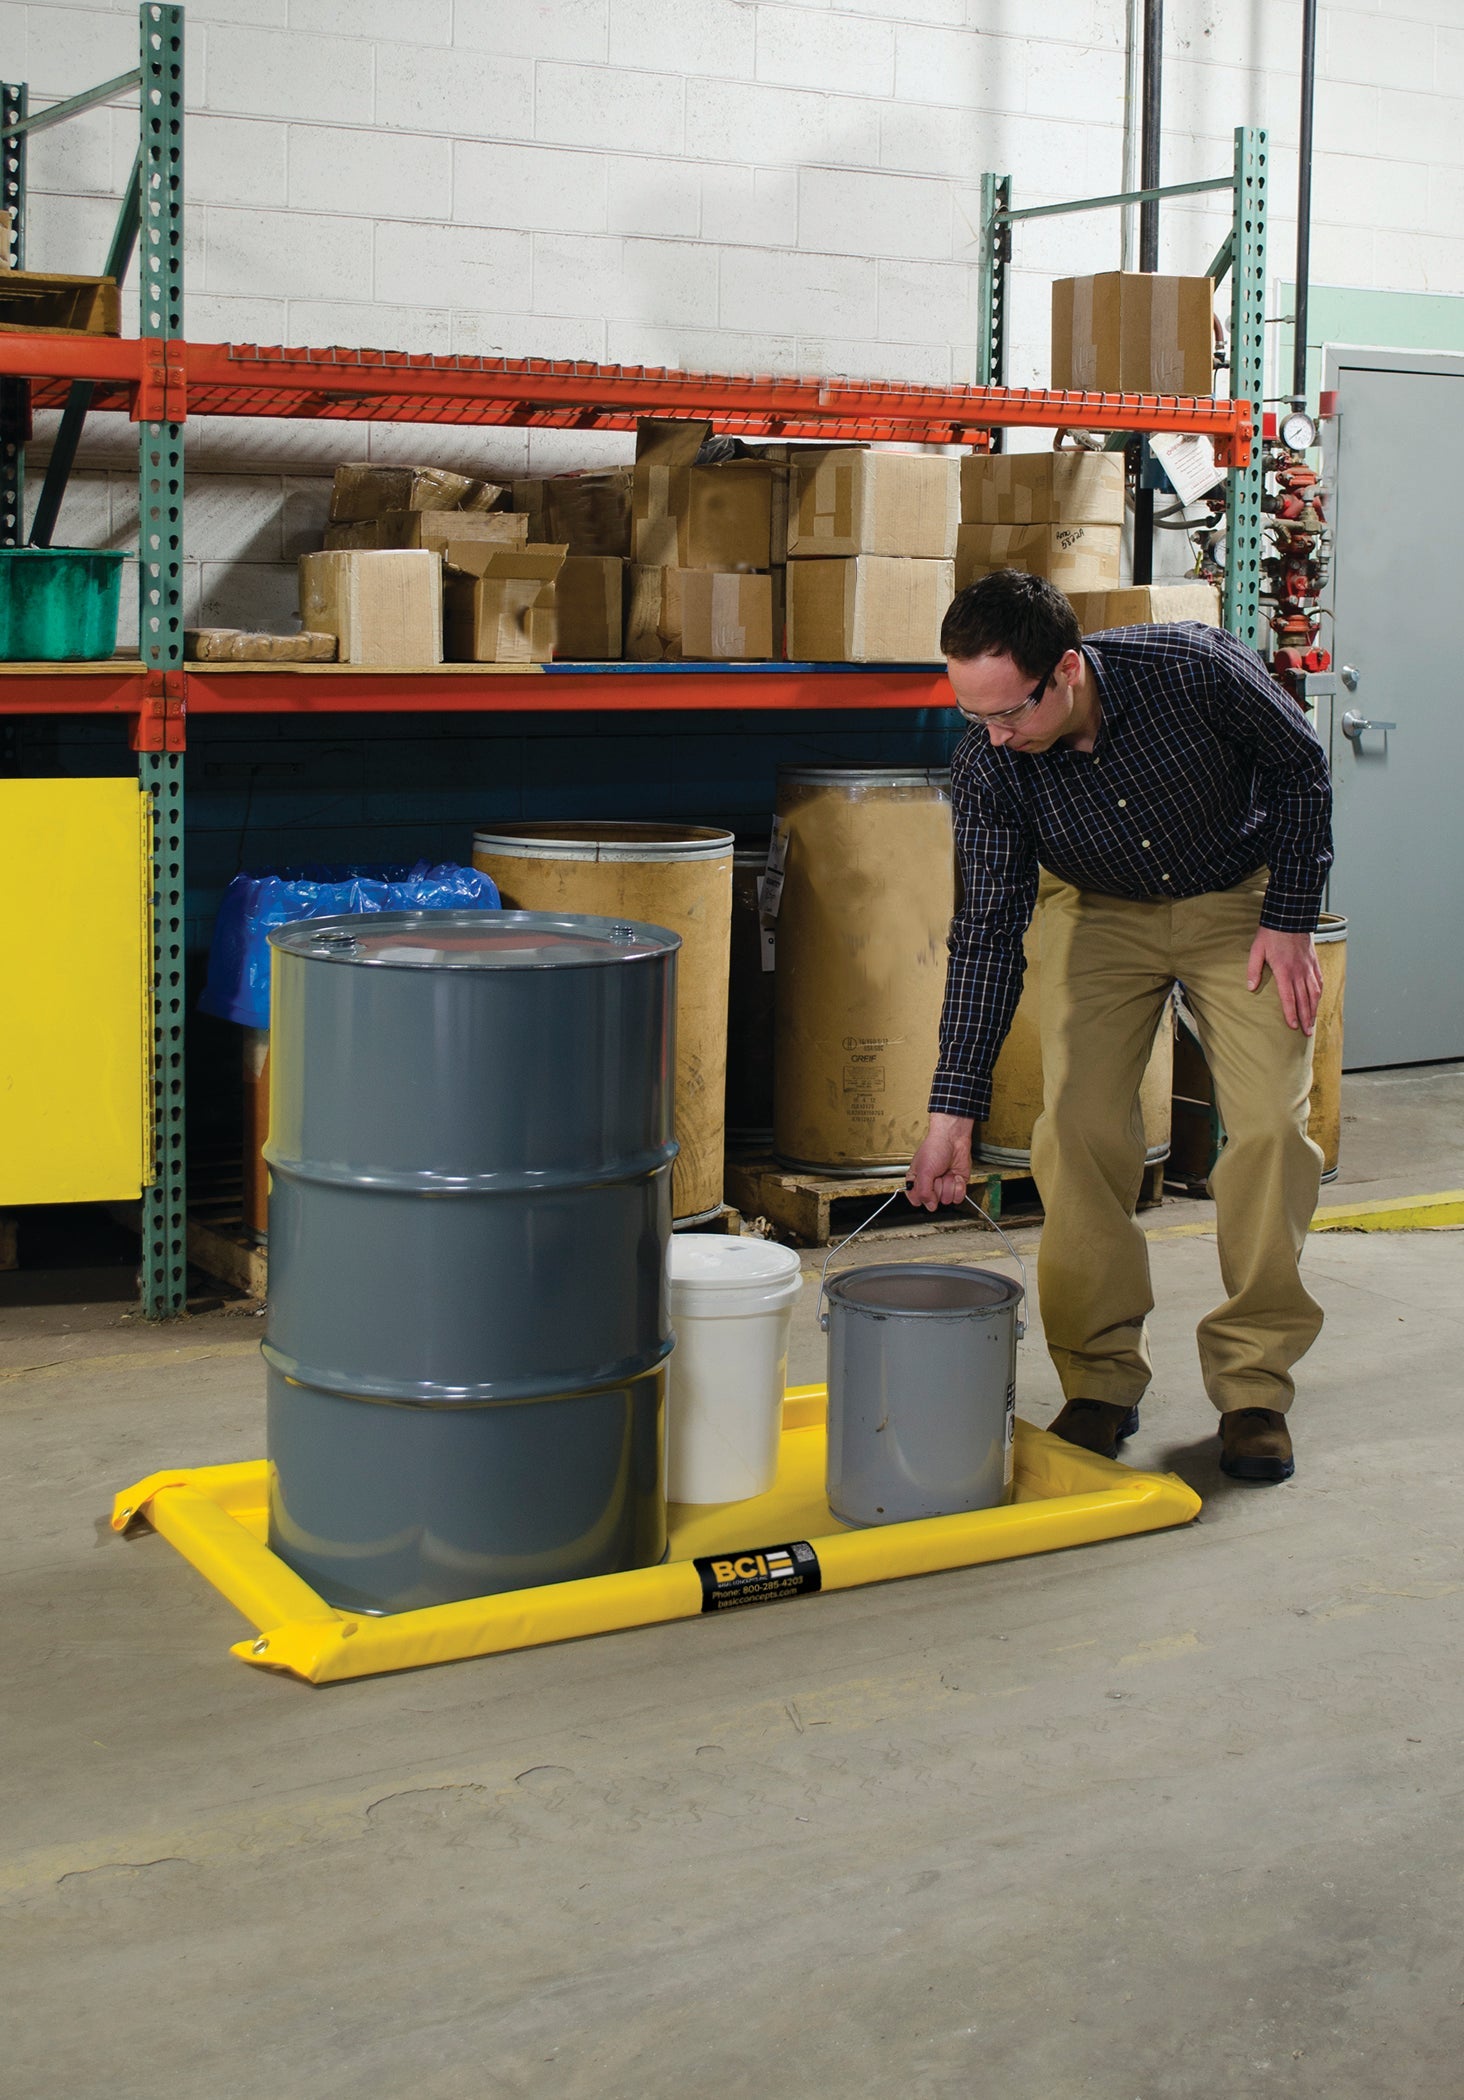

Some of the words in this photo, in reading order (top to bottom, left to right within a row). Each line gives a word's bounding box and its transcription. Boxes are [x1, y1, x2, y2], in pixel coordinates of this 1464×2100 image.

[712, 1589, 740, 1600] Phone:
[742, 1575, 804, 1595] 800-285-4203
[718, 1588, 797, 1608] basicconcepts.com
